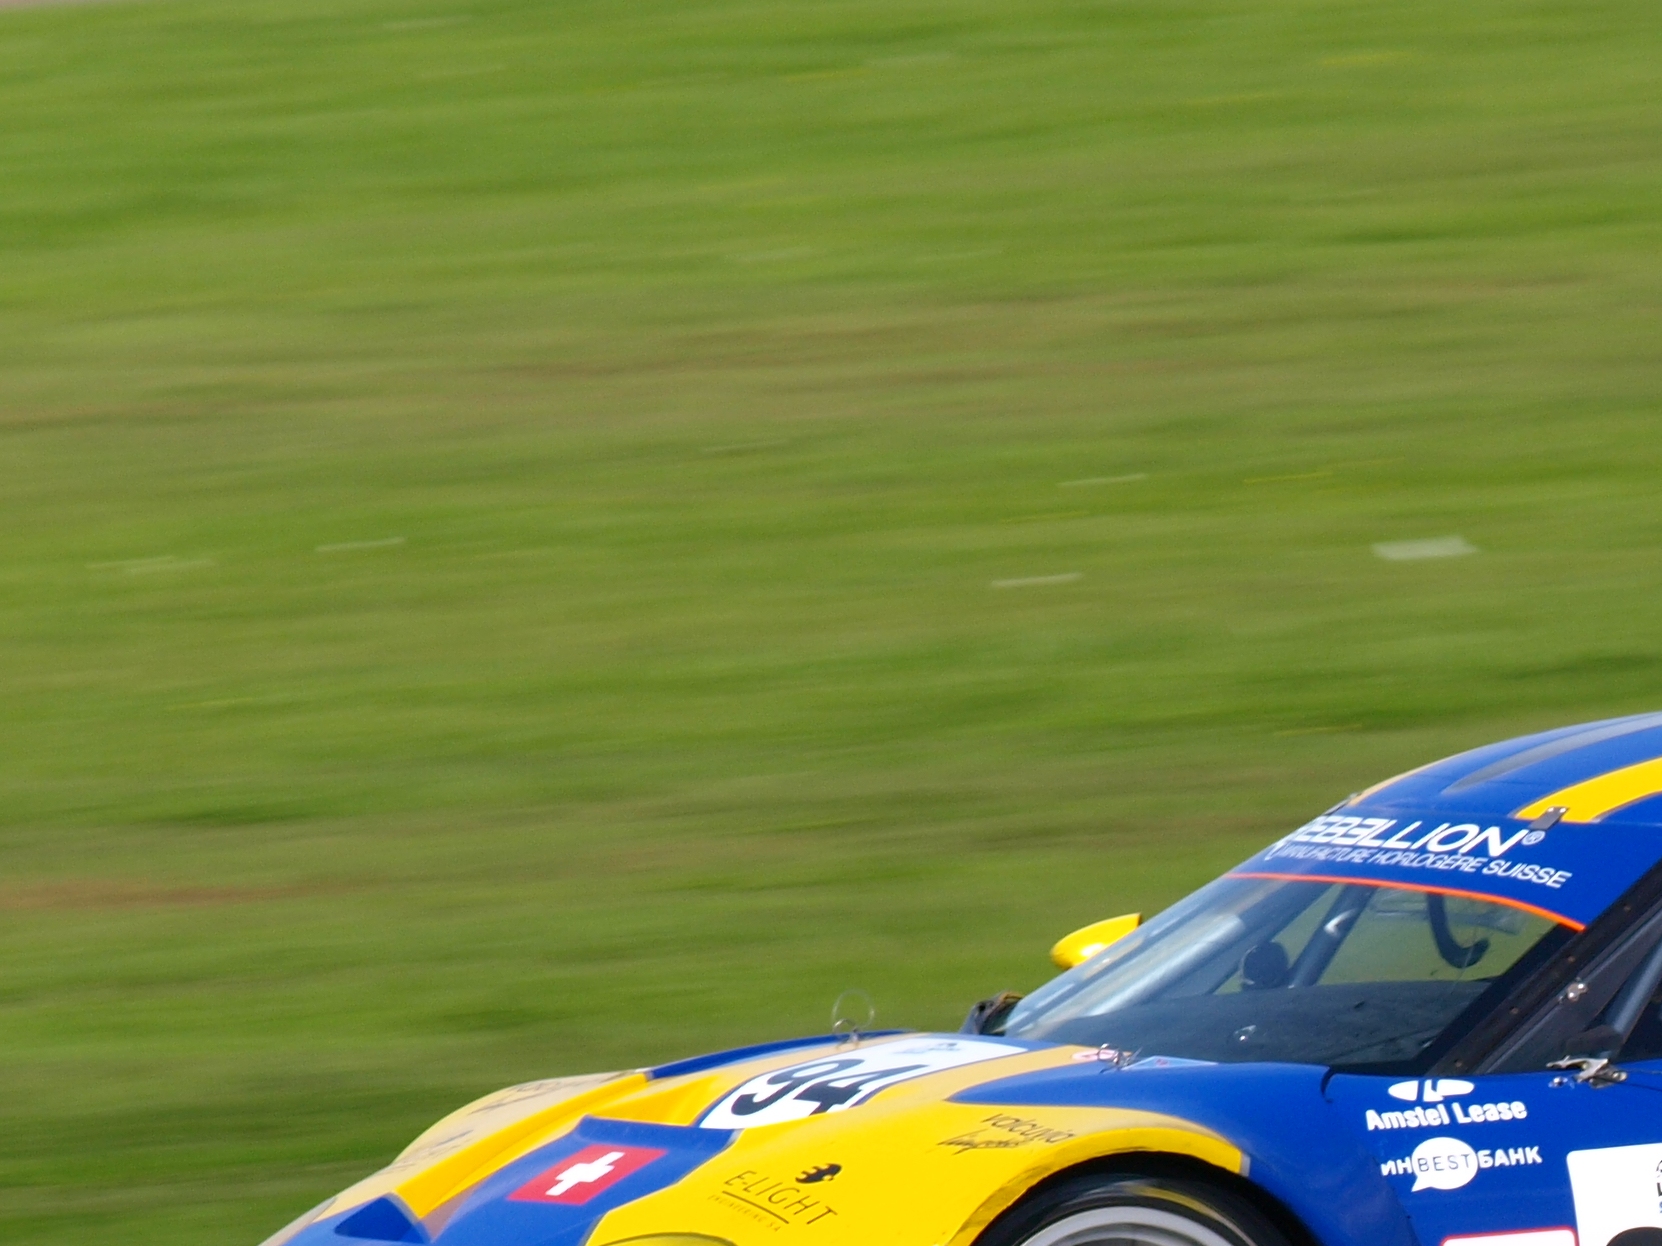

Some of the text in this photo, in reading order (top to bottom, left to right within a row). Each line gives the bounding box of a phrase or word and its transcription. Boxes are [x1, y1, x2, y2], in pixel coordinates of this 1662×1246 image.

[1482, 859, 1573, 888] SUISSE
[731, 1058, 929, 1117] 94
[1366, 1100, 1528, 1131] Amstel Lease
[724, 1169, 838, 1225] E-LIGHT
